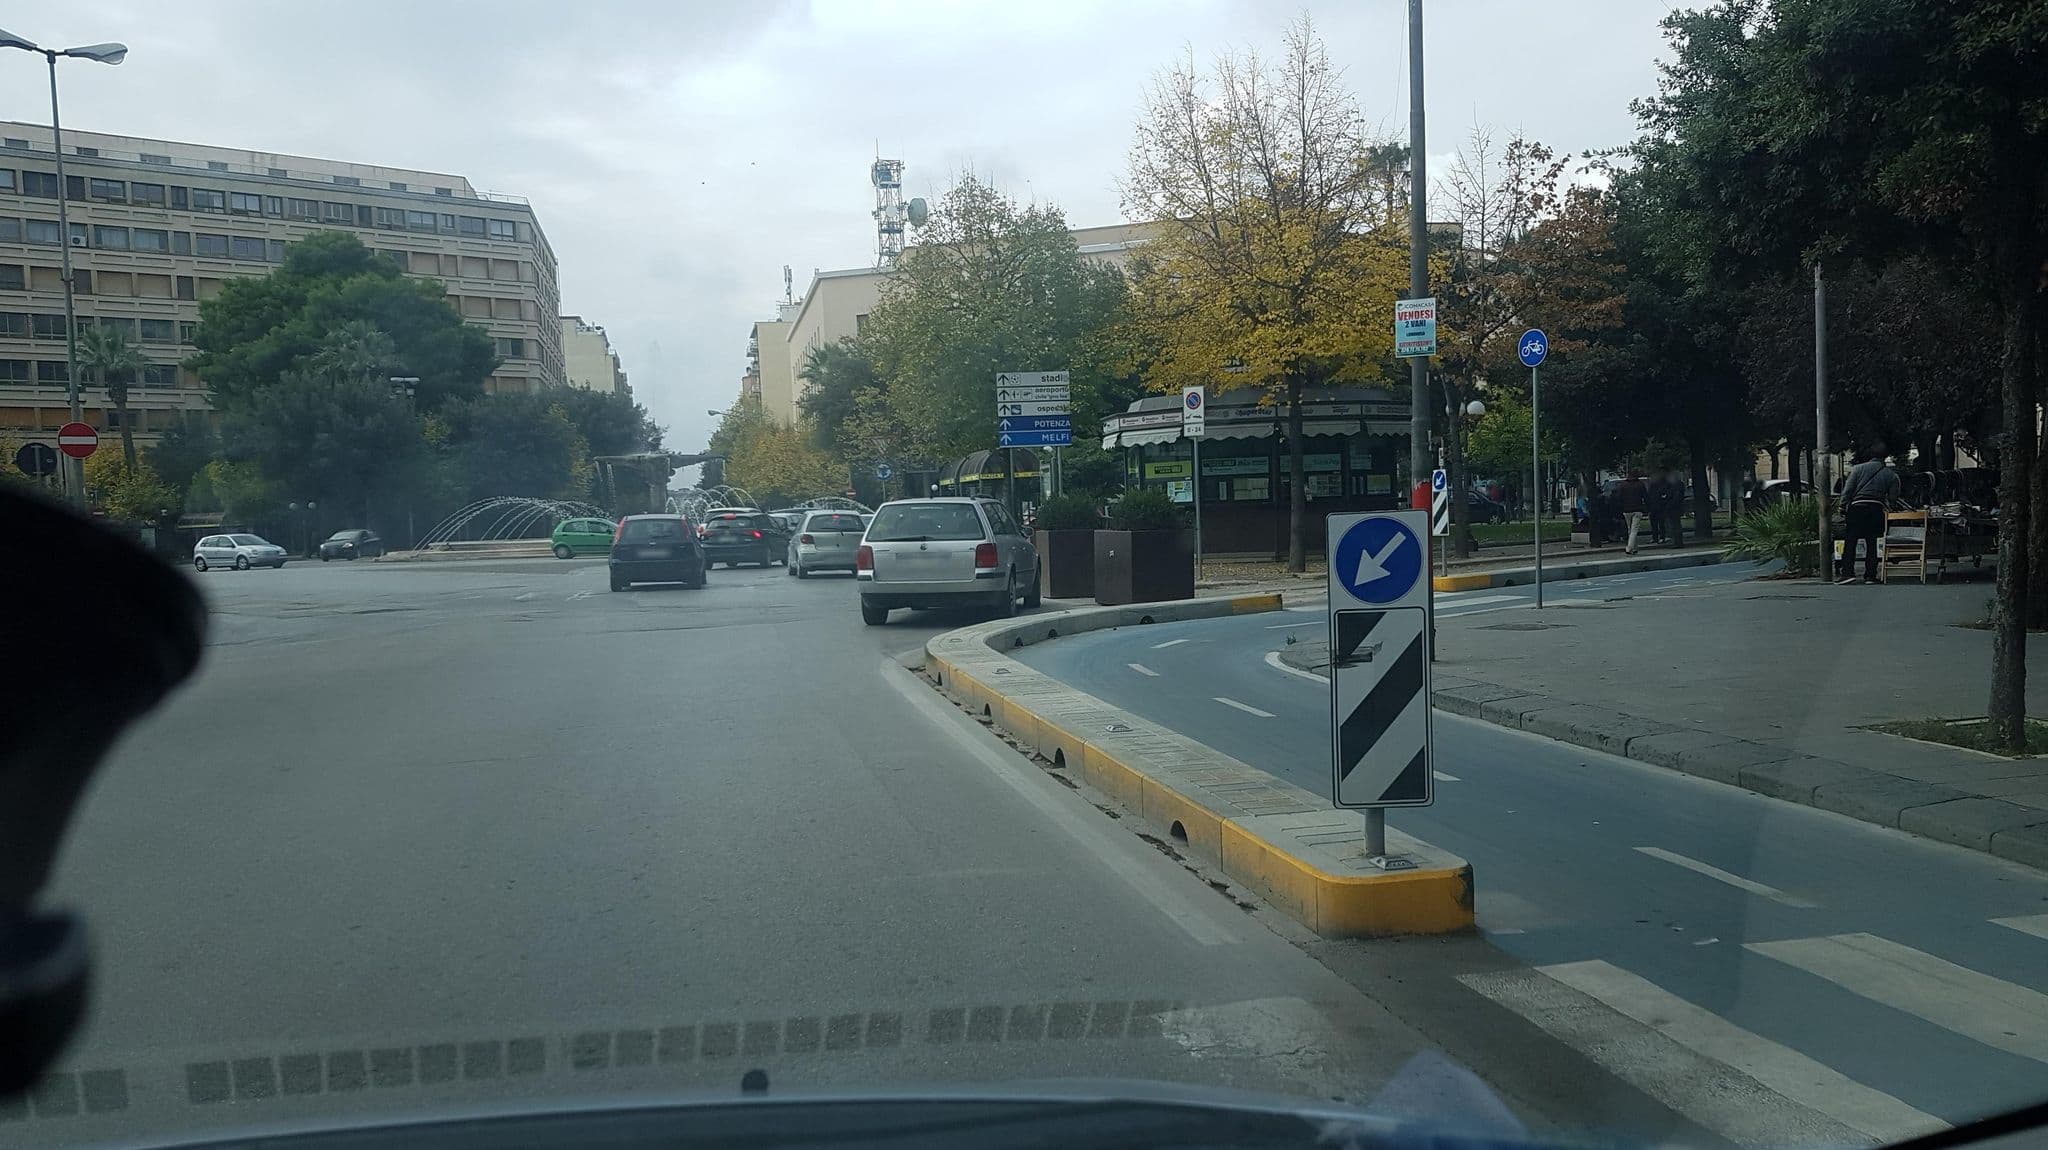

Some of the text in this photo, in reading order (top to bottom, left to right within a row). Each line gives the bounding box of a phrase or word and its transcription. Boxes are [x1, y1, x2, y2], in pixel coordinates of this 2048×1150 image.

[1398, 310, 1433, 321] VENDESI
[1041, 374, 1068, 382] stadi
[1035, 420, 1071, 428] POTENZA
[1042, 433, 1069, 441] MELFI
